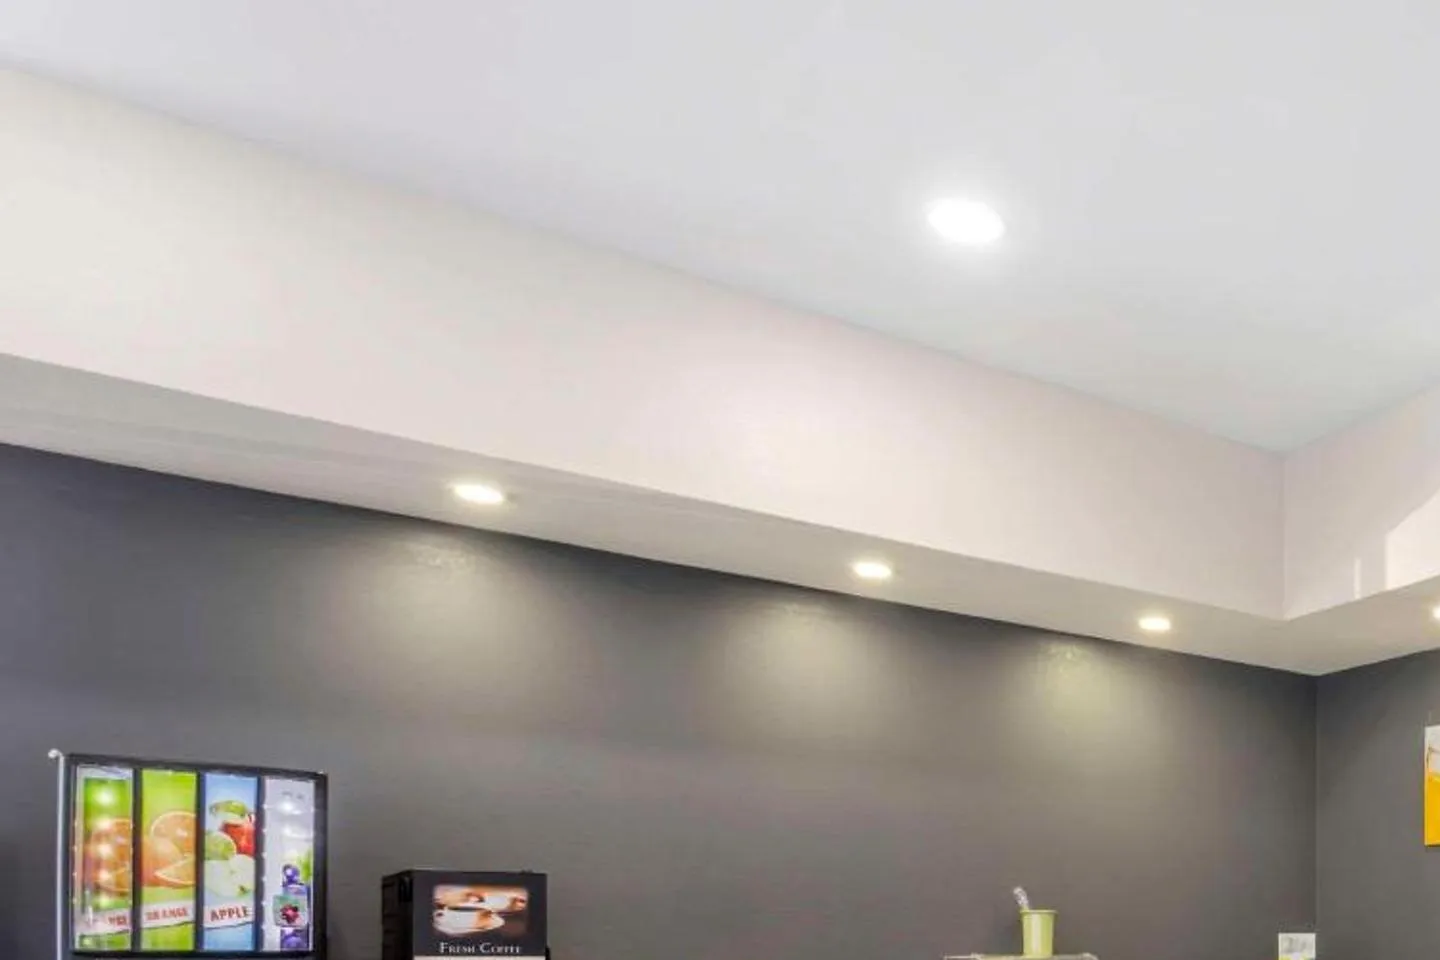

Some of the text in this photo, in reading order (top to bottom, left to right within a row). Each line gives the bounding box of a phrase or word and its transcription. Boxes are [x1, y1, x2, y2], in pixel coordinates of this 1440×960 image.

[145, 906, 189, 922] ORANGE
[210, 905, 250, 922] APPLE
[439, 941, 521, 954] FRESH COFFEE
